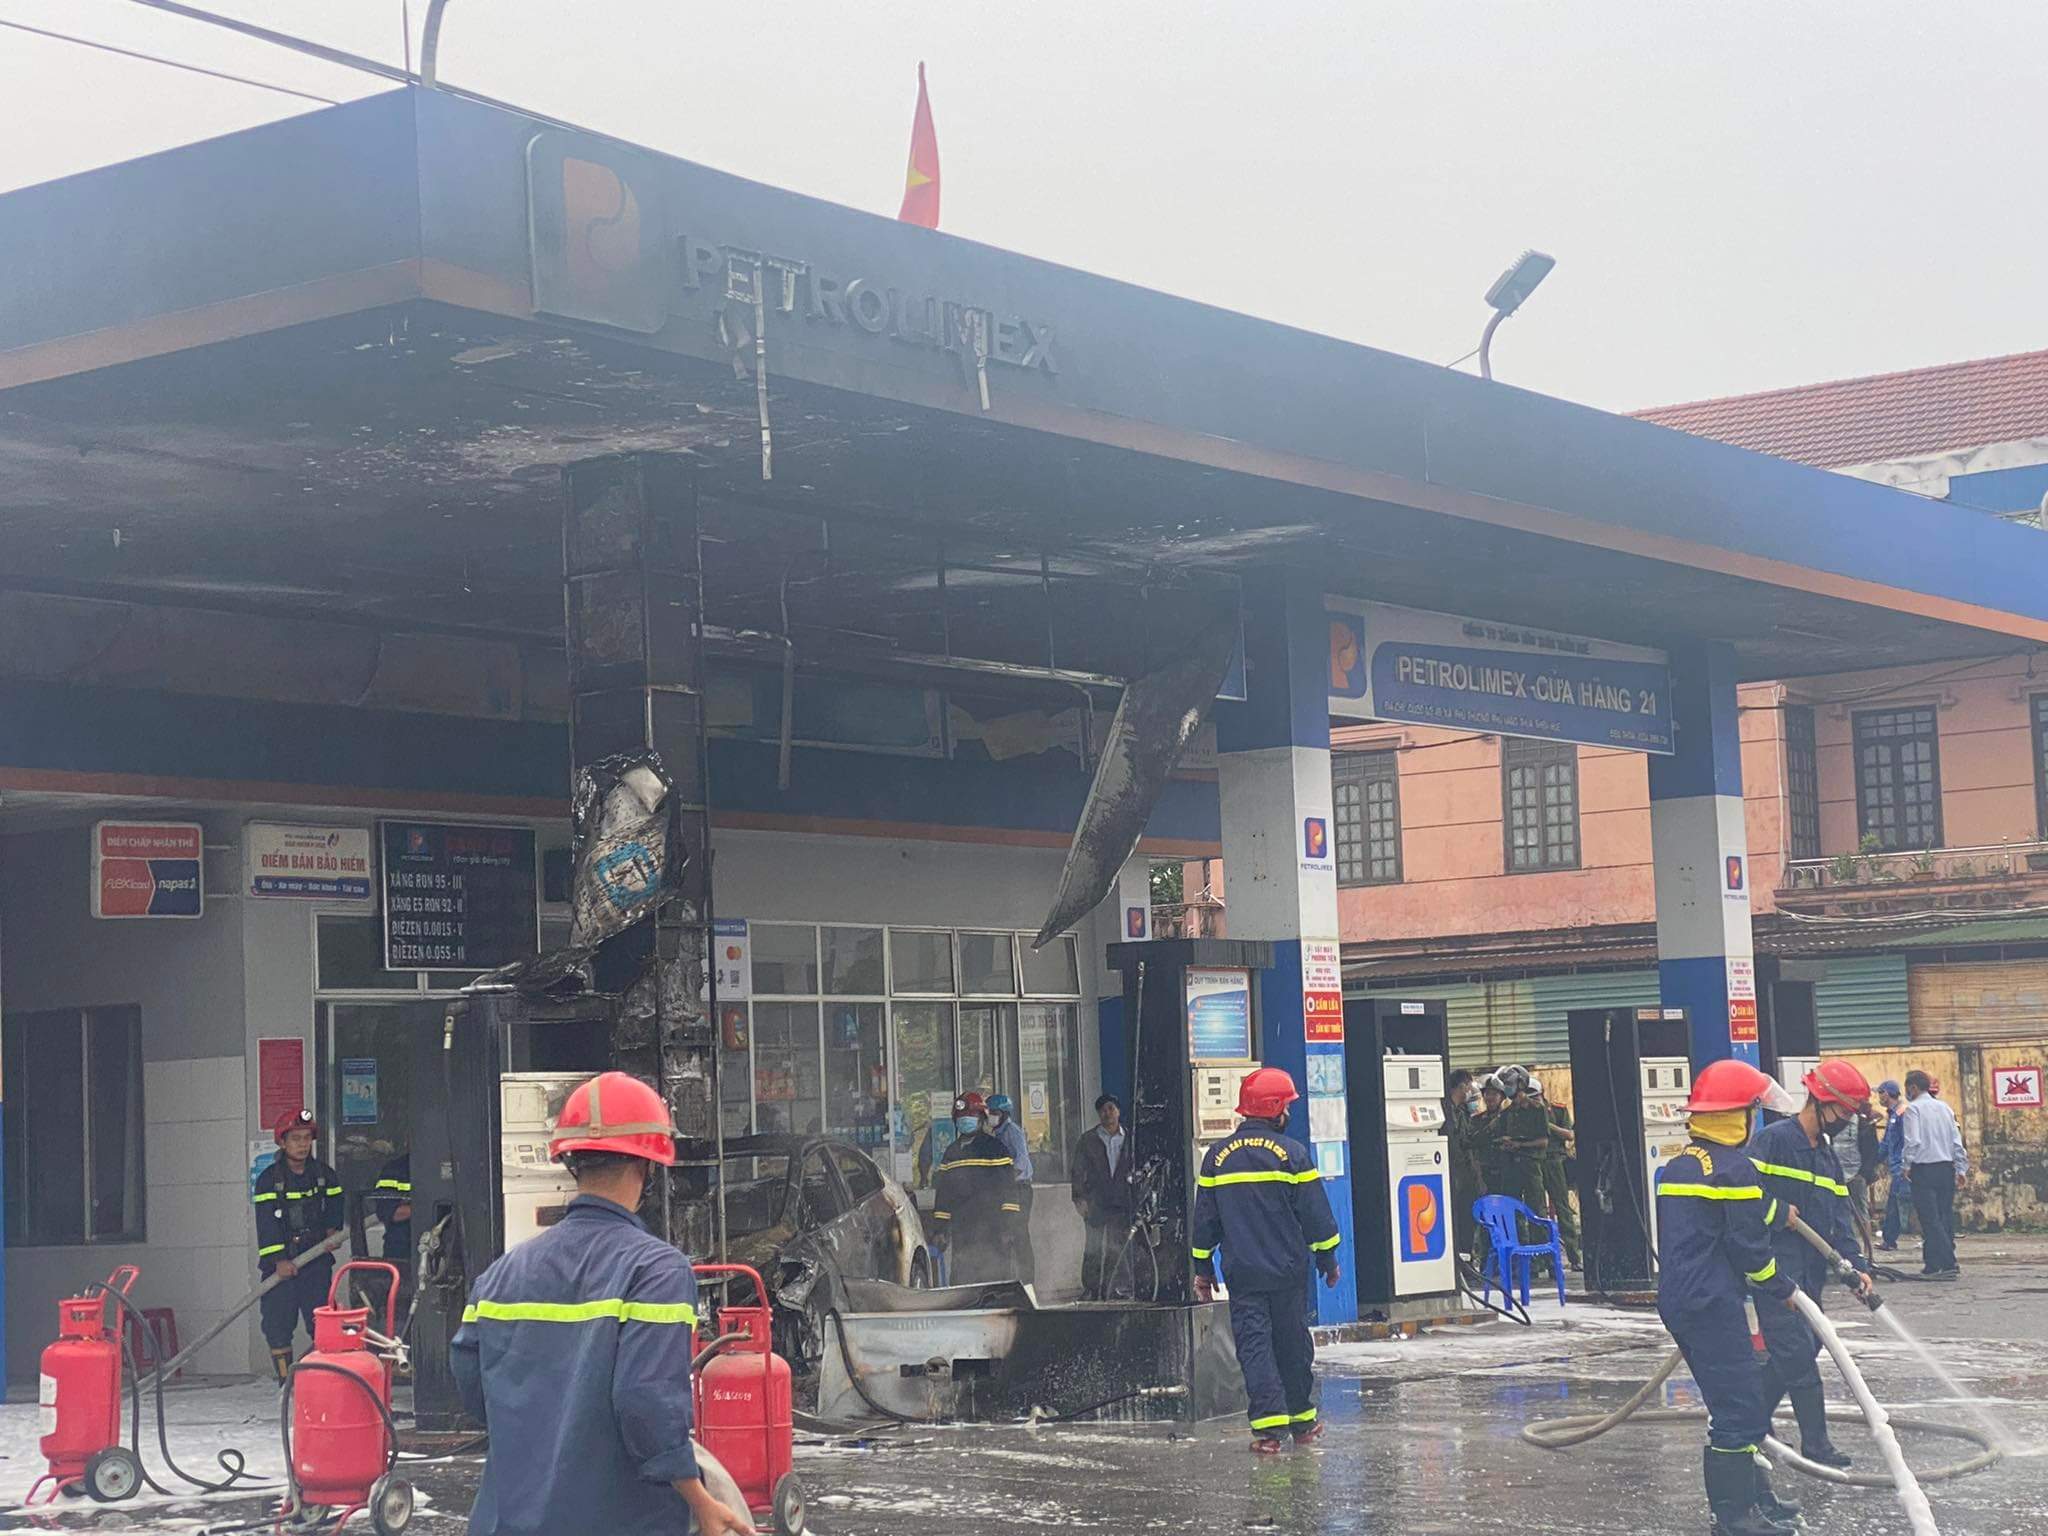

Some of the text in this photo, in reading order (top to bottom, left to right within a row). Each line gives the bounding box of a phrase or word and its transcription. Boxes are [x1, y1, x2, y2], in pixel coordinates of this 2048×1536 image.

[681, 233, 1059, 375] PETROLIMEX
[1396, 655, 1527, 699] PETROLIMEX
[1640, 690, 1657, 716] 21
[416, 874, 433, 888] RON
[435, 874, 446, 889] 95
[425, 898, 440, 912] RON
[442, 899, 452, 913] 92
